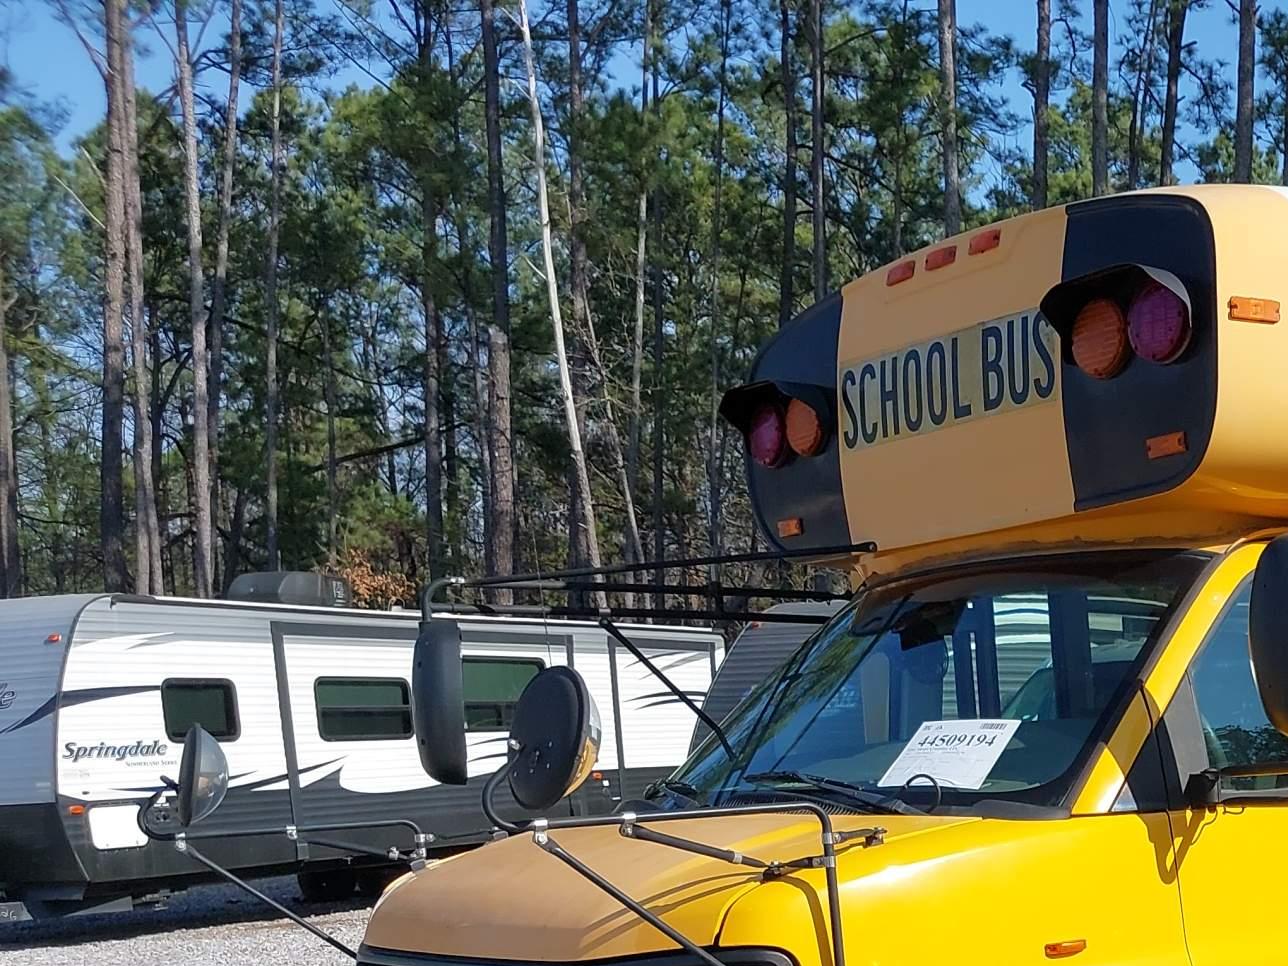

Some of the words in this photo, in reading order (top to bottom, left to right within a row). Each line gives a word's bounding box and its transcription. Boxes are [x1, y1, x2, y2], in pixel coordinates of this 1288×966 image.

[841, 336, 972, 450] SCHOOL
[981, 310, 1055, 412] BUS
[62, 740, 168, 762] Springdale
[918, 734, 998, 747] 44509194
